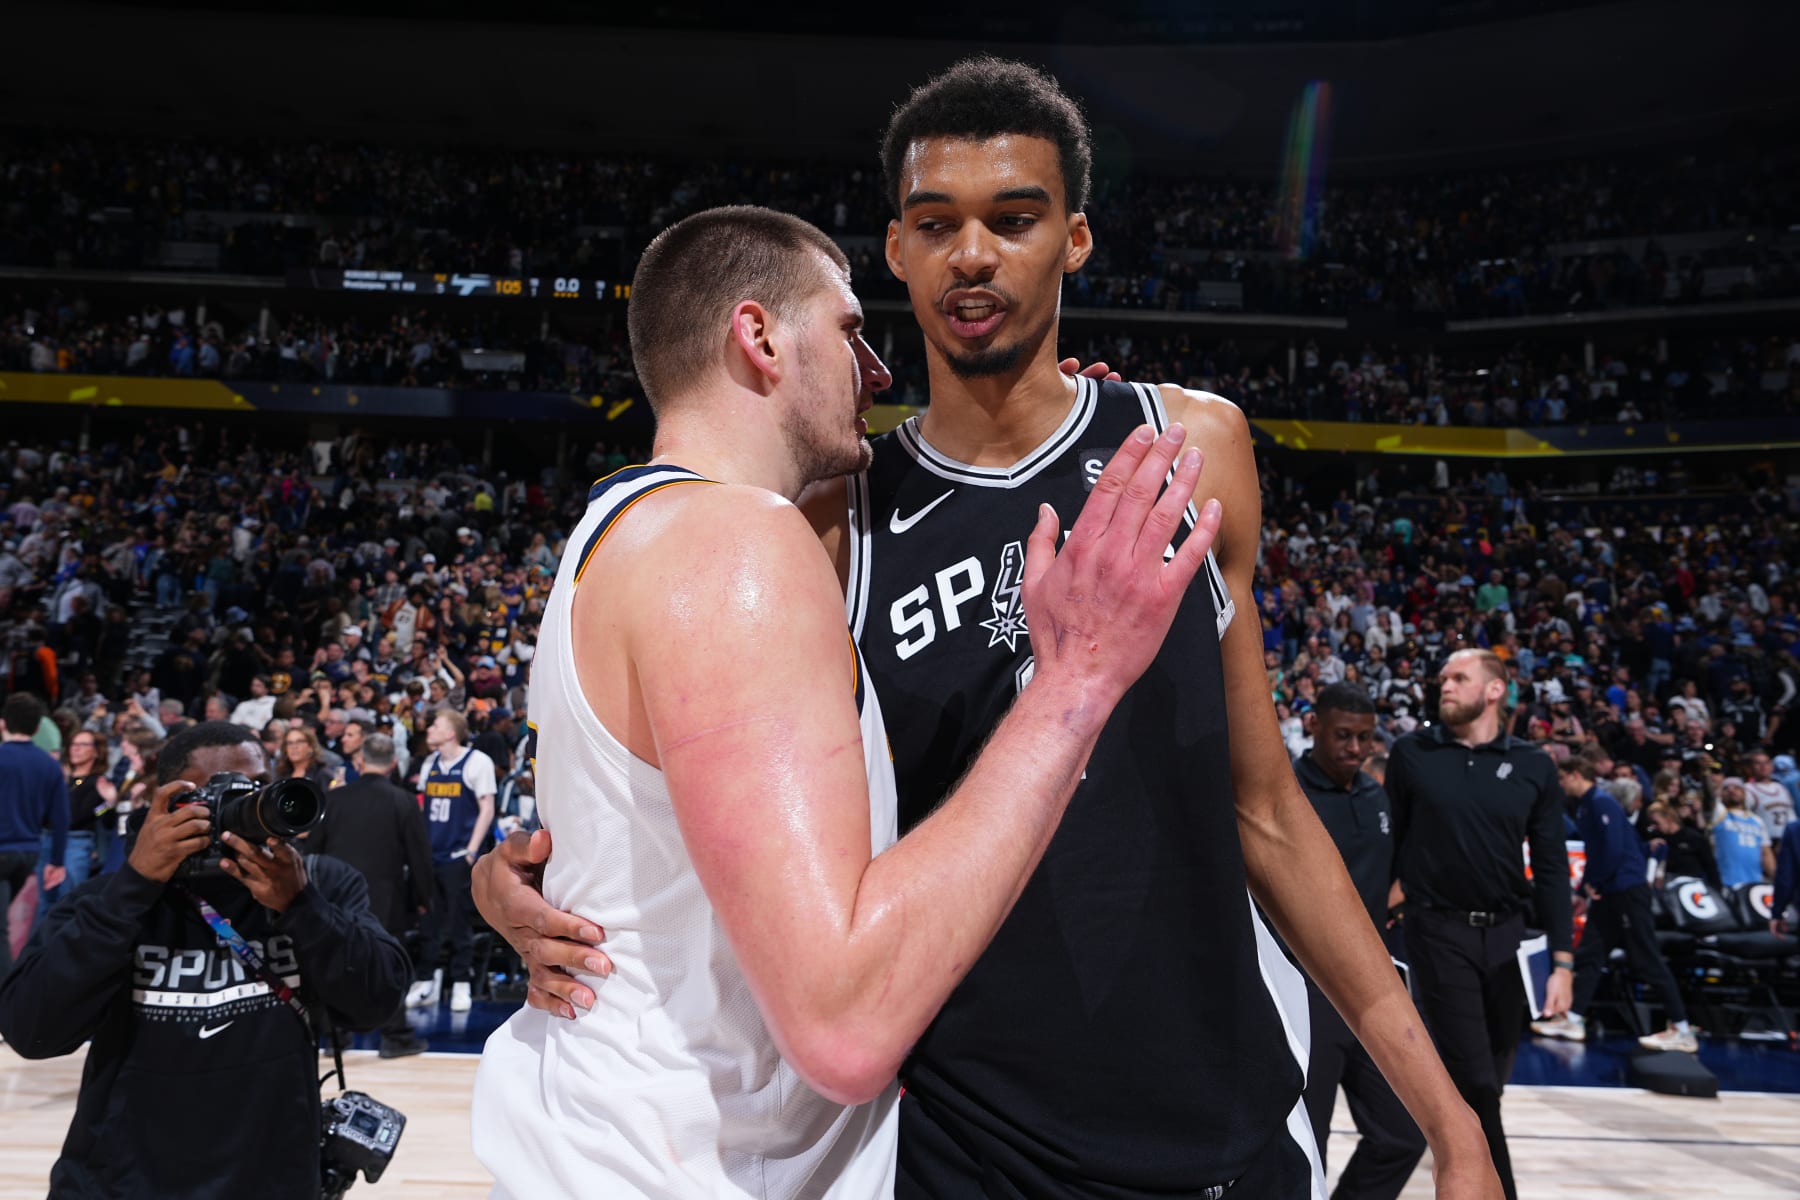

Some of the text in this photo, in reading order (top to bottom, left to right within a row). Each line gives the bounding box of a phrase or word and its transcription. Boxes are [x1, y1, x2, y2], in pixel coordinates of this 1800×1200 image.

[495, 279, 523, 295] 105
[553, 278, 580, 293] 0.0
[429, 797, 451, 822] 50
[1679, 881, 1718, 919] G
